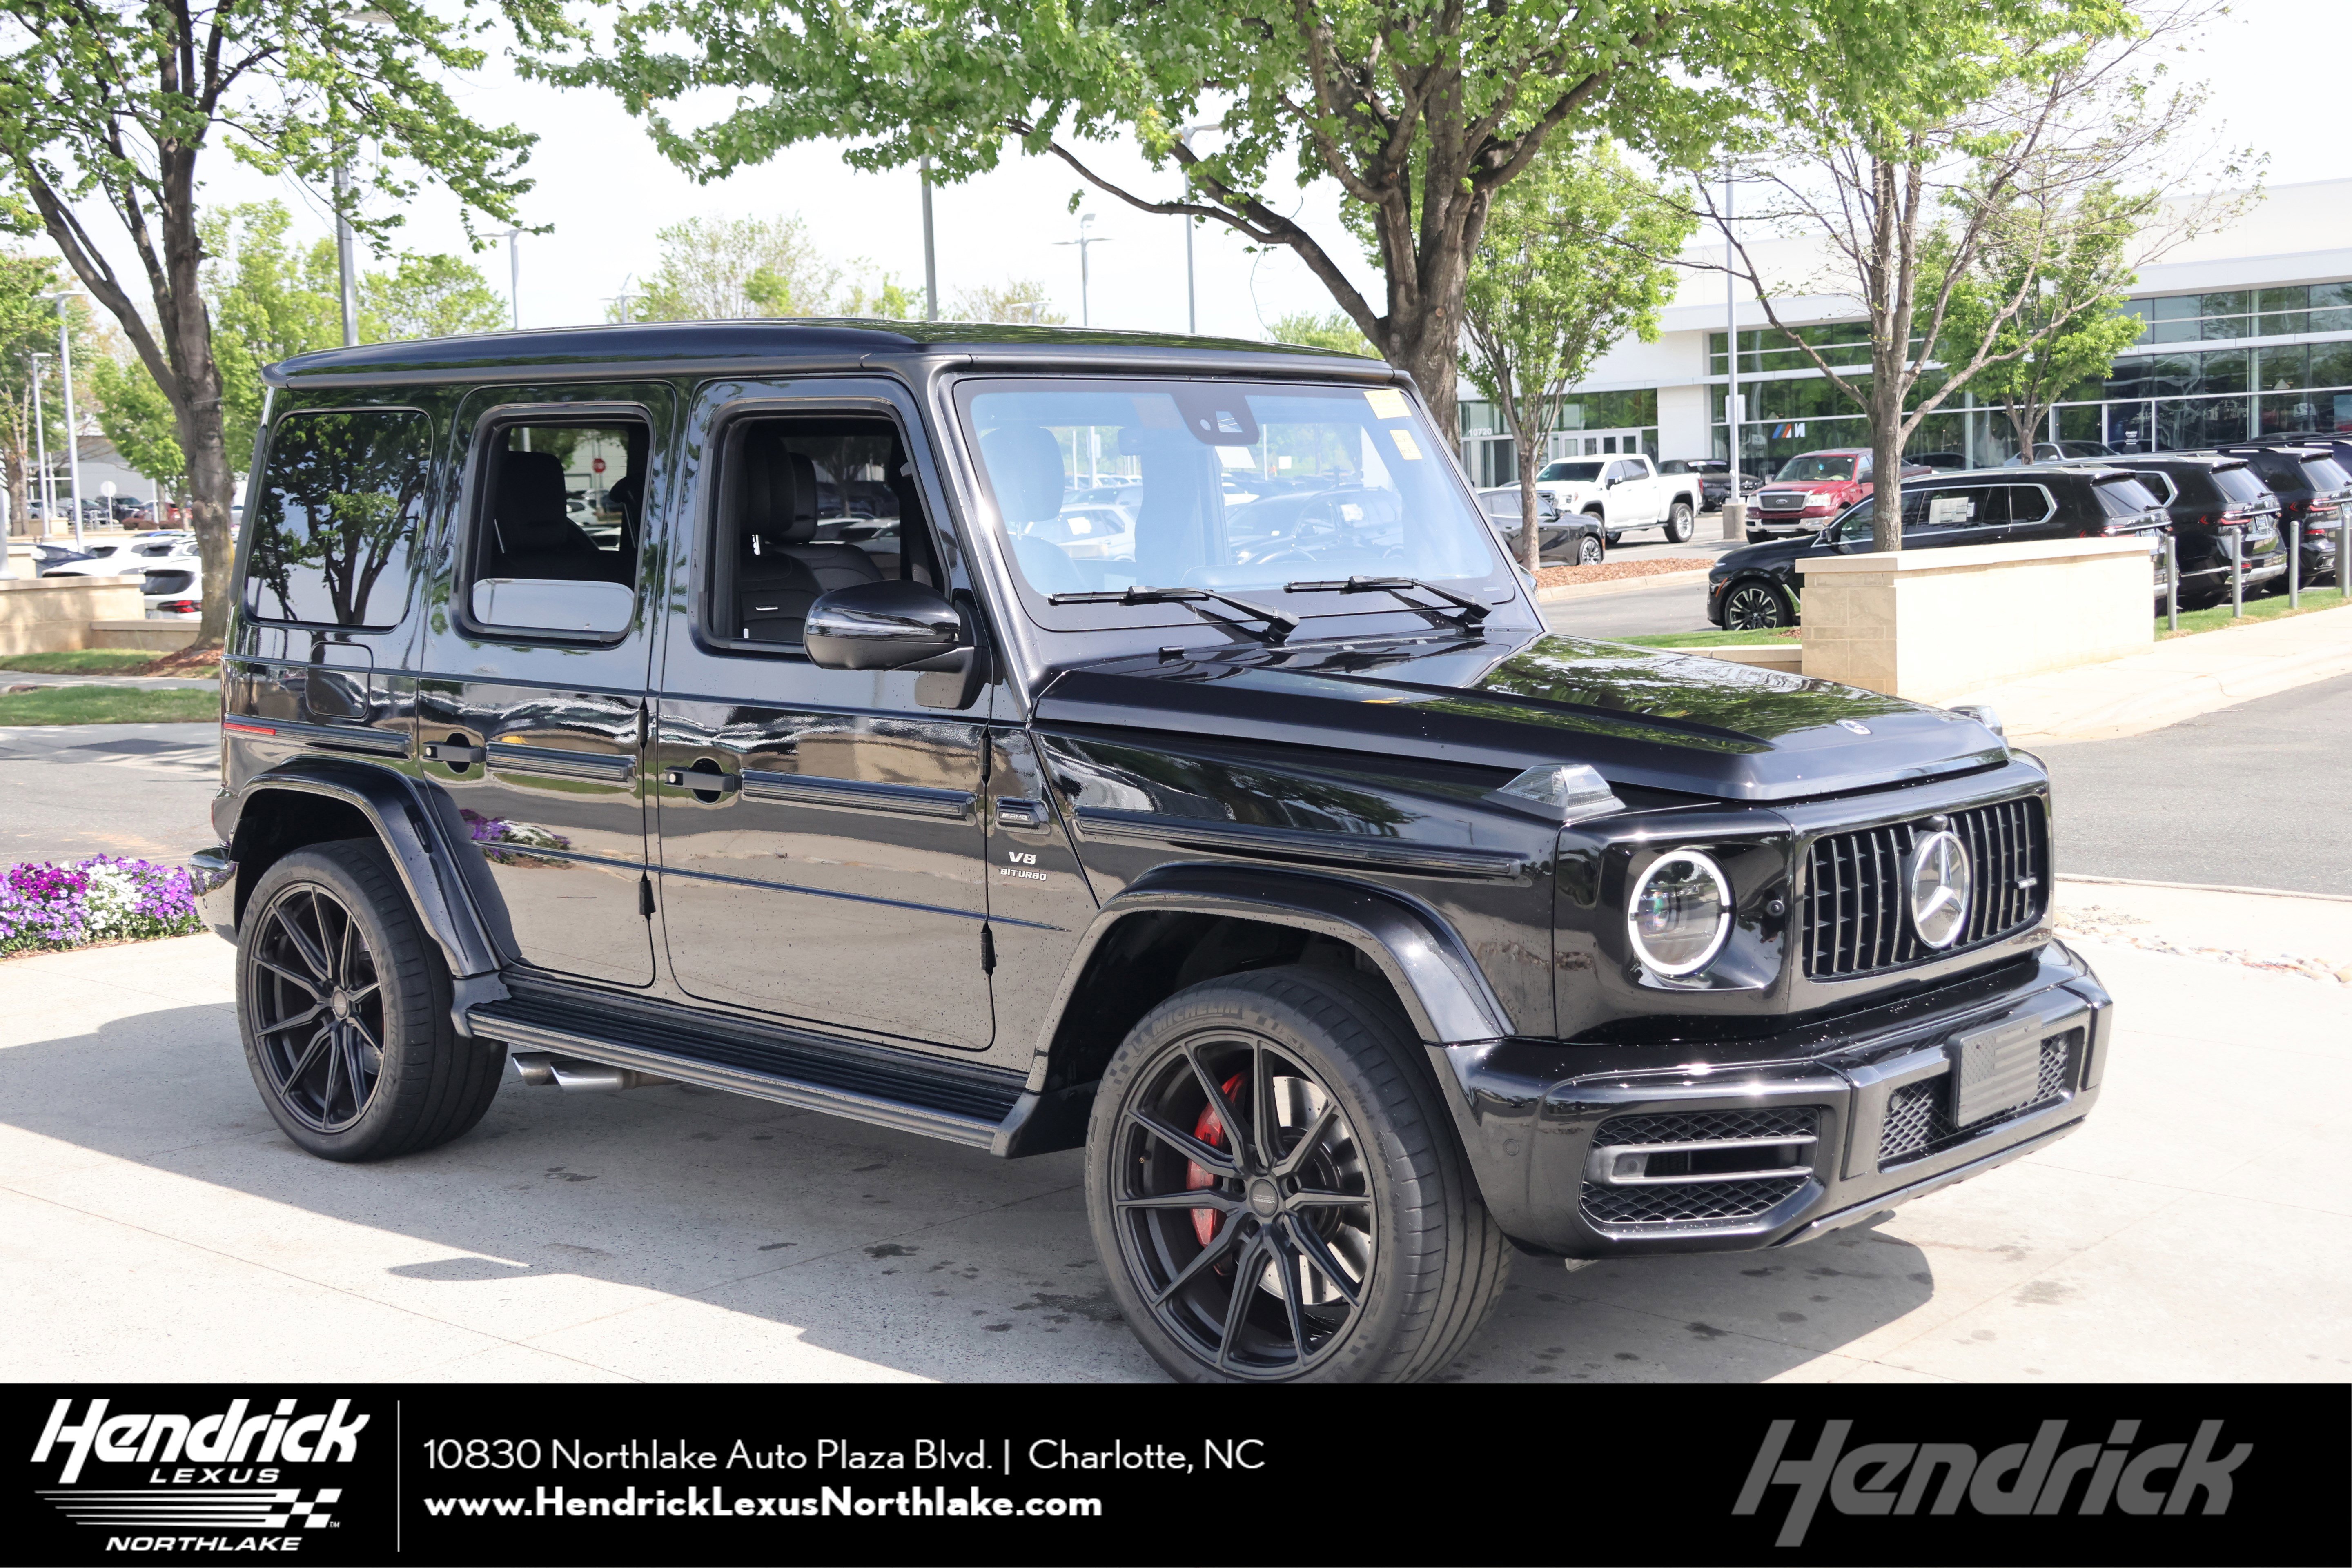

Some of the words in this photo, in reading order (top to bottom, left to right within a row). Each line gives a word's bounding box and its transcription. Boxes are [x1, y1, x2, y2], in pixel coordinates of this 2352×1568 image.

[1468, 427, 1492, 437] 10720
[1009, 851, 1036, 865] V8
[1000, 868, 1047, 881] BITURBO
[1152, 1000, 1240, 1036] MICHELIN
